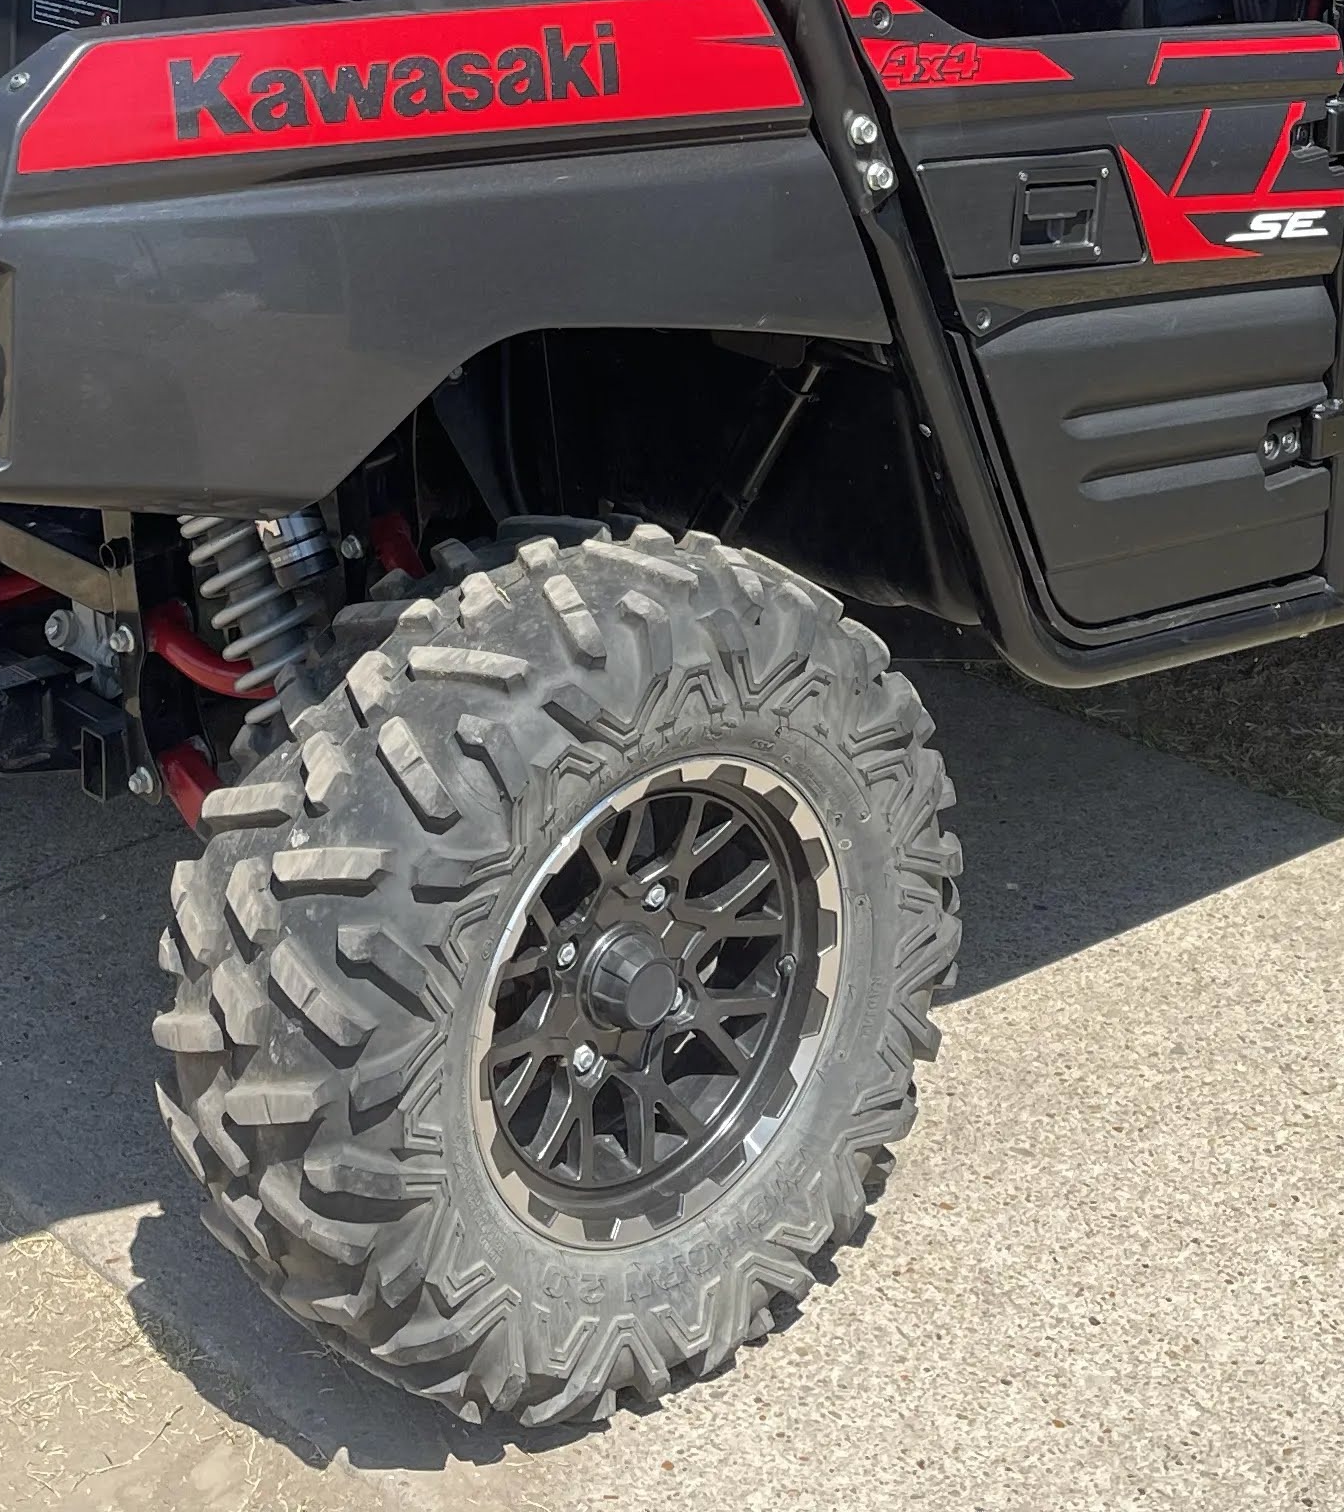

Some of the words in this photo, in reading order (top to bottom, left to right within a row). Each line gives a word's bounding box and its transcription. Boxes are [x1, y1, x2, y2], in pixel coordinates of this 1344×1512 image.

[169, 22, 622, 141] Kawasaki
[881, 41, 979, 84] 4x4
[1225, 210, 1329, 243] SE
